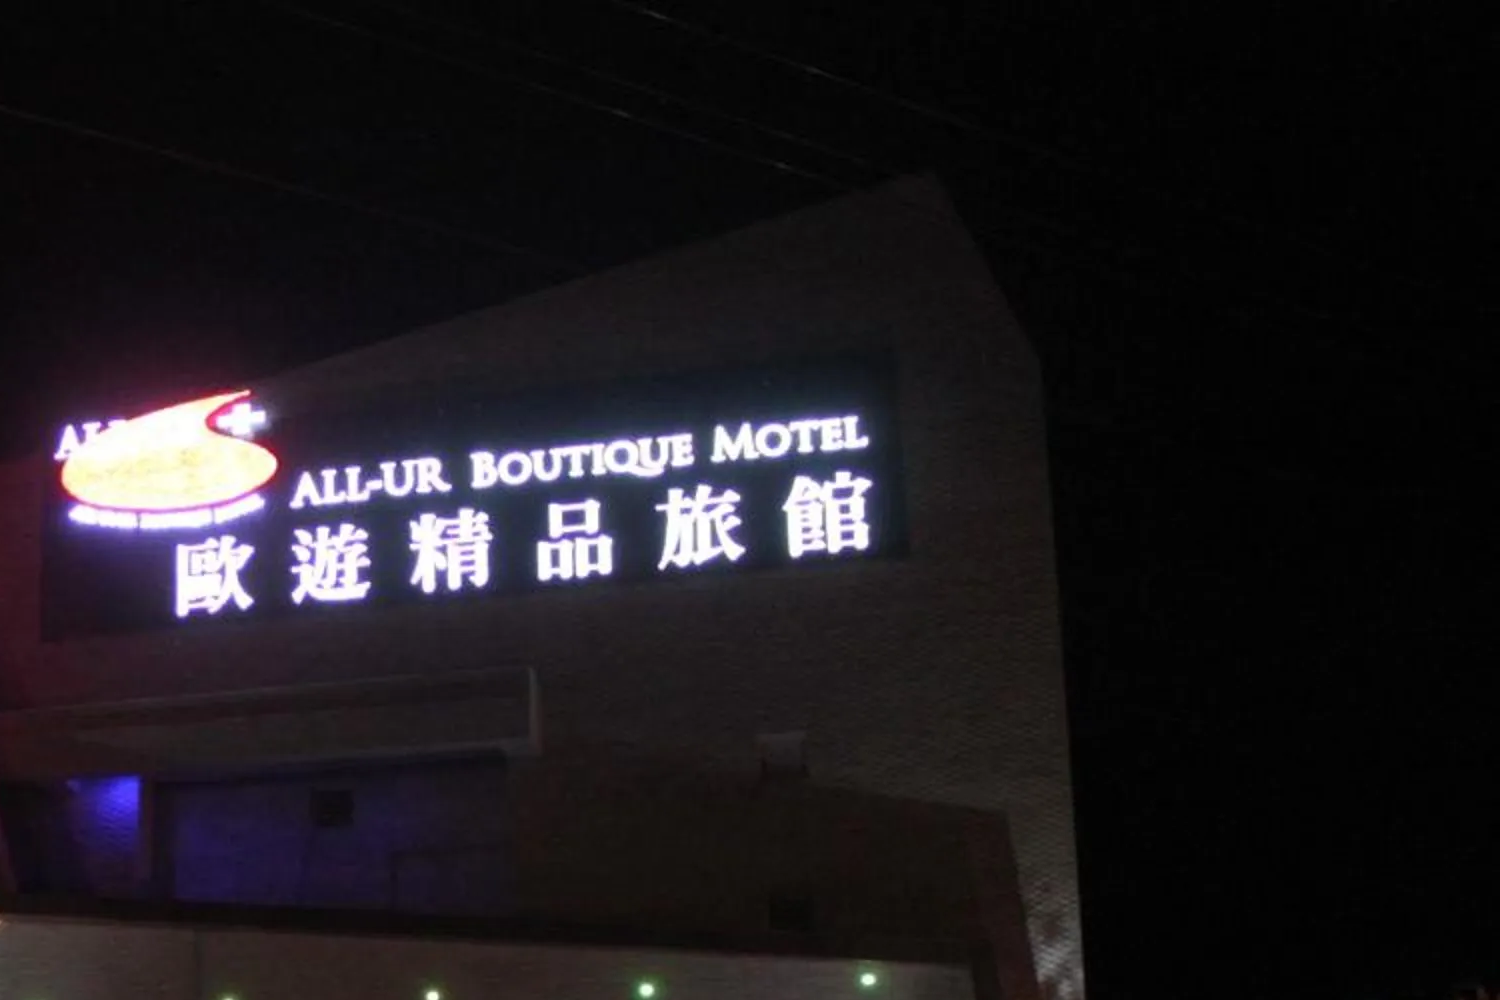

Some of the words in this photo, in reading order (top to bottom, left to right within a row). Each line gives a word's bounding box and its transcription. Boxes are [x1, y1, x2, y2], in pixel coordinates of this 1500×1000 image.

[289, 456, 453, 509] ALL-UR
[469, 433, 695, 491] BOUTIQUE
[710, 414, 870, 464] MOTEL
[174, 470, 874, 620] 歐遊精品旅館
